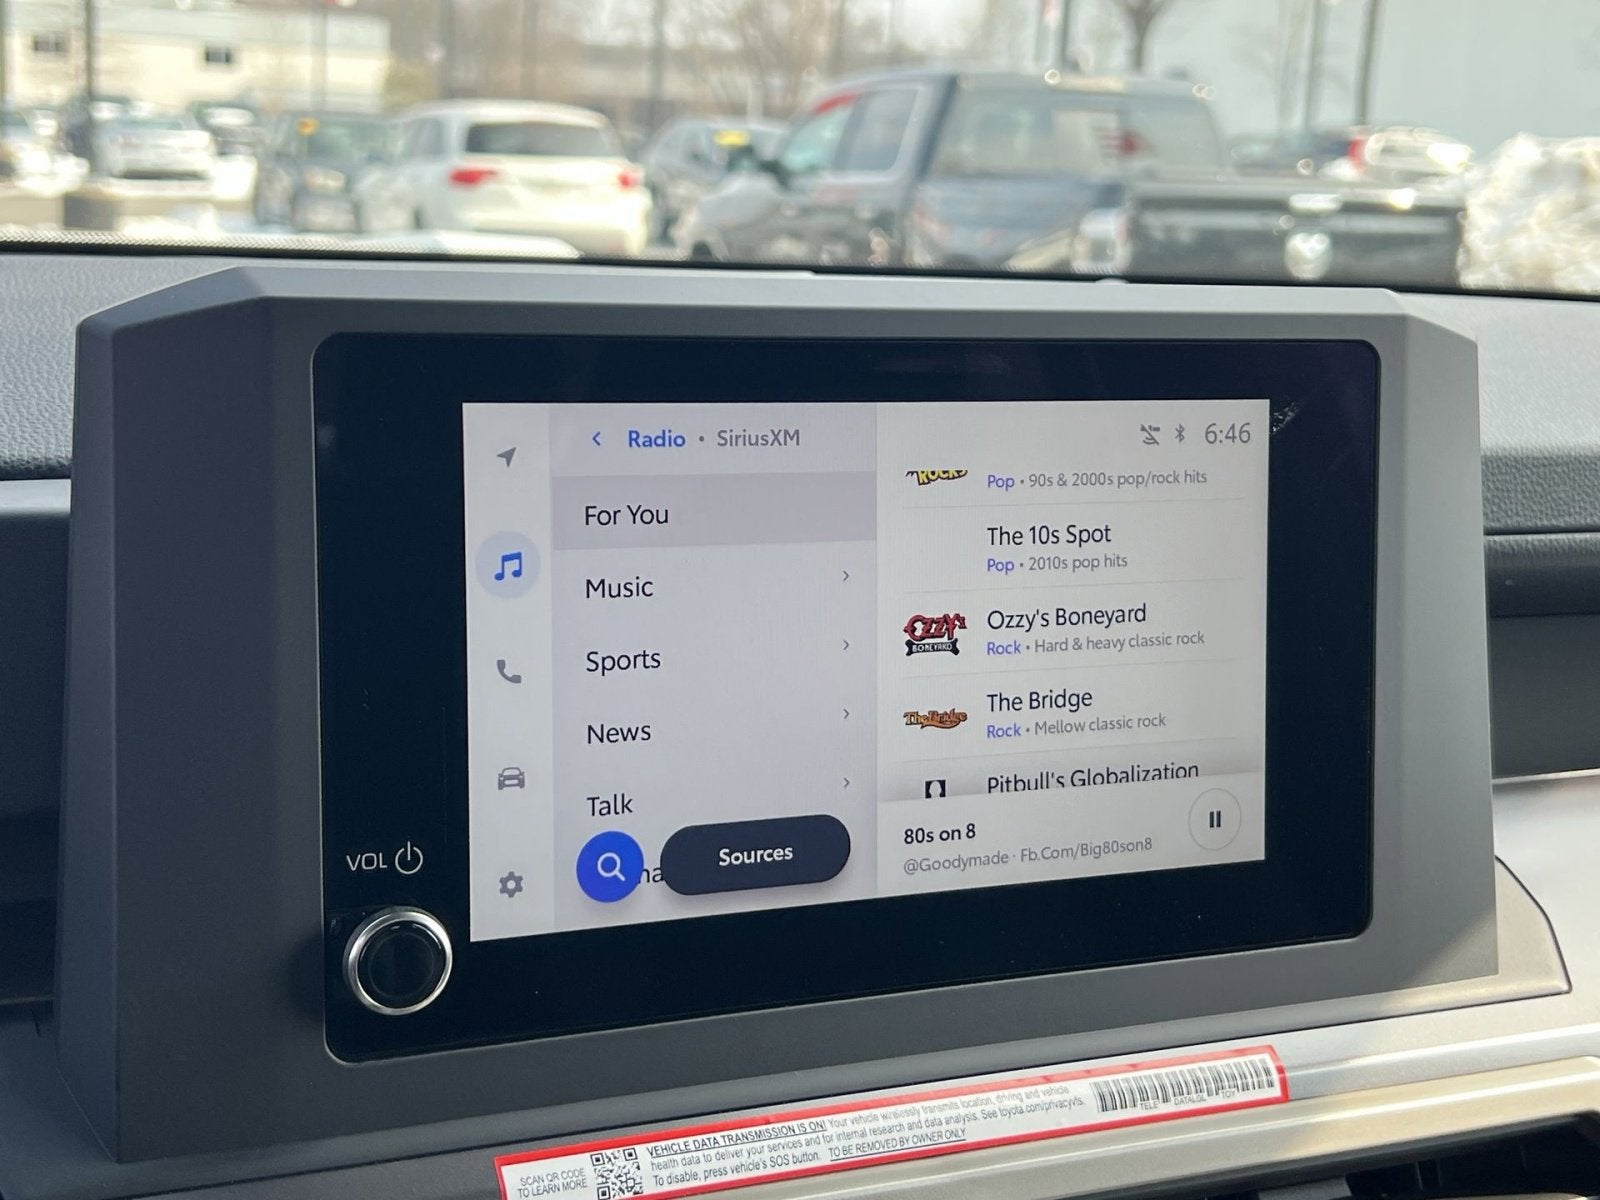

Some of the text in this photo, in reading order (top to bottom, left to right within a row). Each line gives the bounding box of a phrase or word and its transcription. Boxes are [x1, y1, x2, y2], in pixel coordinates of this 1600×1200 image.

[628, 428, 800, 448] Radio SiriusXM
[1204, 422, 1251, 444] 6:46
[987, 469, 1207, 492] Pop 90s & 2000s pop/rock hits
[584, 504, 669, 526] For You
[987, 524, 1111, 547] The 10s Spot
[987, 553, 1128, 575] Pop 2010s pop hits
[586, 576, 653, 599] Music
[987, 603, 1146, 633] Ozzy's Boneyard
[987, 630, 1205, 655] Rock Hard & heavy classic rock
[586, 650, 661, 676] Sports
[987, 688, 1093, 714] The Bridge
[587, 723, 651, 745] News
[987, 713, 1166, 738] Rock Mellow classic rock
[988, 762, 1199, 793] Pitbull's Globalization
[587, 793, 634, 817] Talk
[904, 823, 976, 845] 80s on 8
[346, 852, 388, 872] VOL
[718, 843, 794, 866] Sources
[904, 837, 1153, 875] @Goodymade Fb.Com/Big80son8
[1140, 1101, 1158, 1111] TELE
[1220, 1089, 1236, 1100] TOY
[646, 1140, 691, 1157] VEHICLE
[693, 1136, 720, 1150] DATA
[720, 1124, 796, 1145] TRANSMISSION
[797, 1122, 807, 1133] IS
[809, 1119, 827, 1131] ON!
[828, 1117, 848, 1129] Your
[850, 1112, 879, 1125] vehicle
[880, 1106, 920, 1121] wirelessly
[921, 1100, 959, 1114] transmits
[996, 1091, 1024, 1104] driving
[1025, 1088, 1040, 1099] and
[1041, 1084, 1069, 1097] vehicle
[651, 1157, 679, 1172] health
[681, 1154, 701, 1167] data
[703, 1153, 713, 1163] to
[715, 1147, 744, 1162] deliver
[746, 1144, 765, 1157] your
[767, 1138, 803, 1153] services
[805, 1135, 821, 1147] and
[822, 1132, 834, 1144] for
[836, 1127, 867, 1141] internal
[868, 1122, 905, 1137] research
[906, 1118, 923, 1131] and
[925, 1116, 943, 1129] data
[944, 1111, 980, 1126] analysis.
[982, 1108, 998, 1119] See
[828, 1127, 966, 1158] TO BE REMOVED BY OWNER ONLY
[520, 1167, 586, 1187] SCAN QR CODE
[653, 1174, 664, 1187] To
[666, 1170, 701, 1185] disable,
[703, 1167, 728, 1182] press
[729, 1159, 768, 1174] vehicle's
[769, 1153, 790, 1168] SOS
[518, 1178, 588, 1198] TO LEARN MORE
